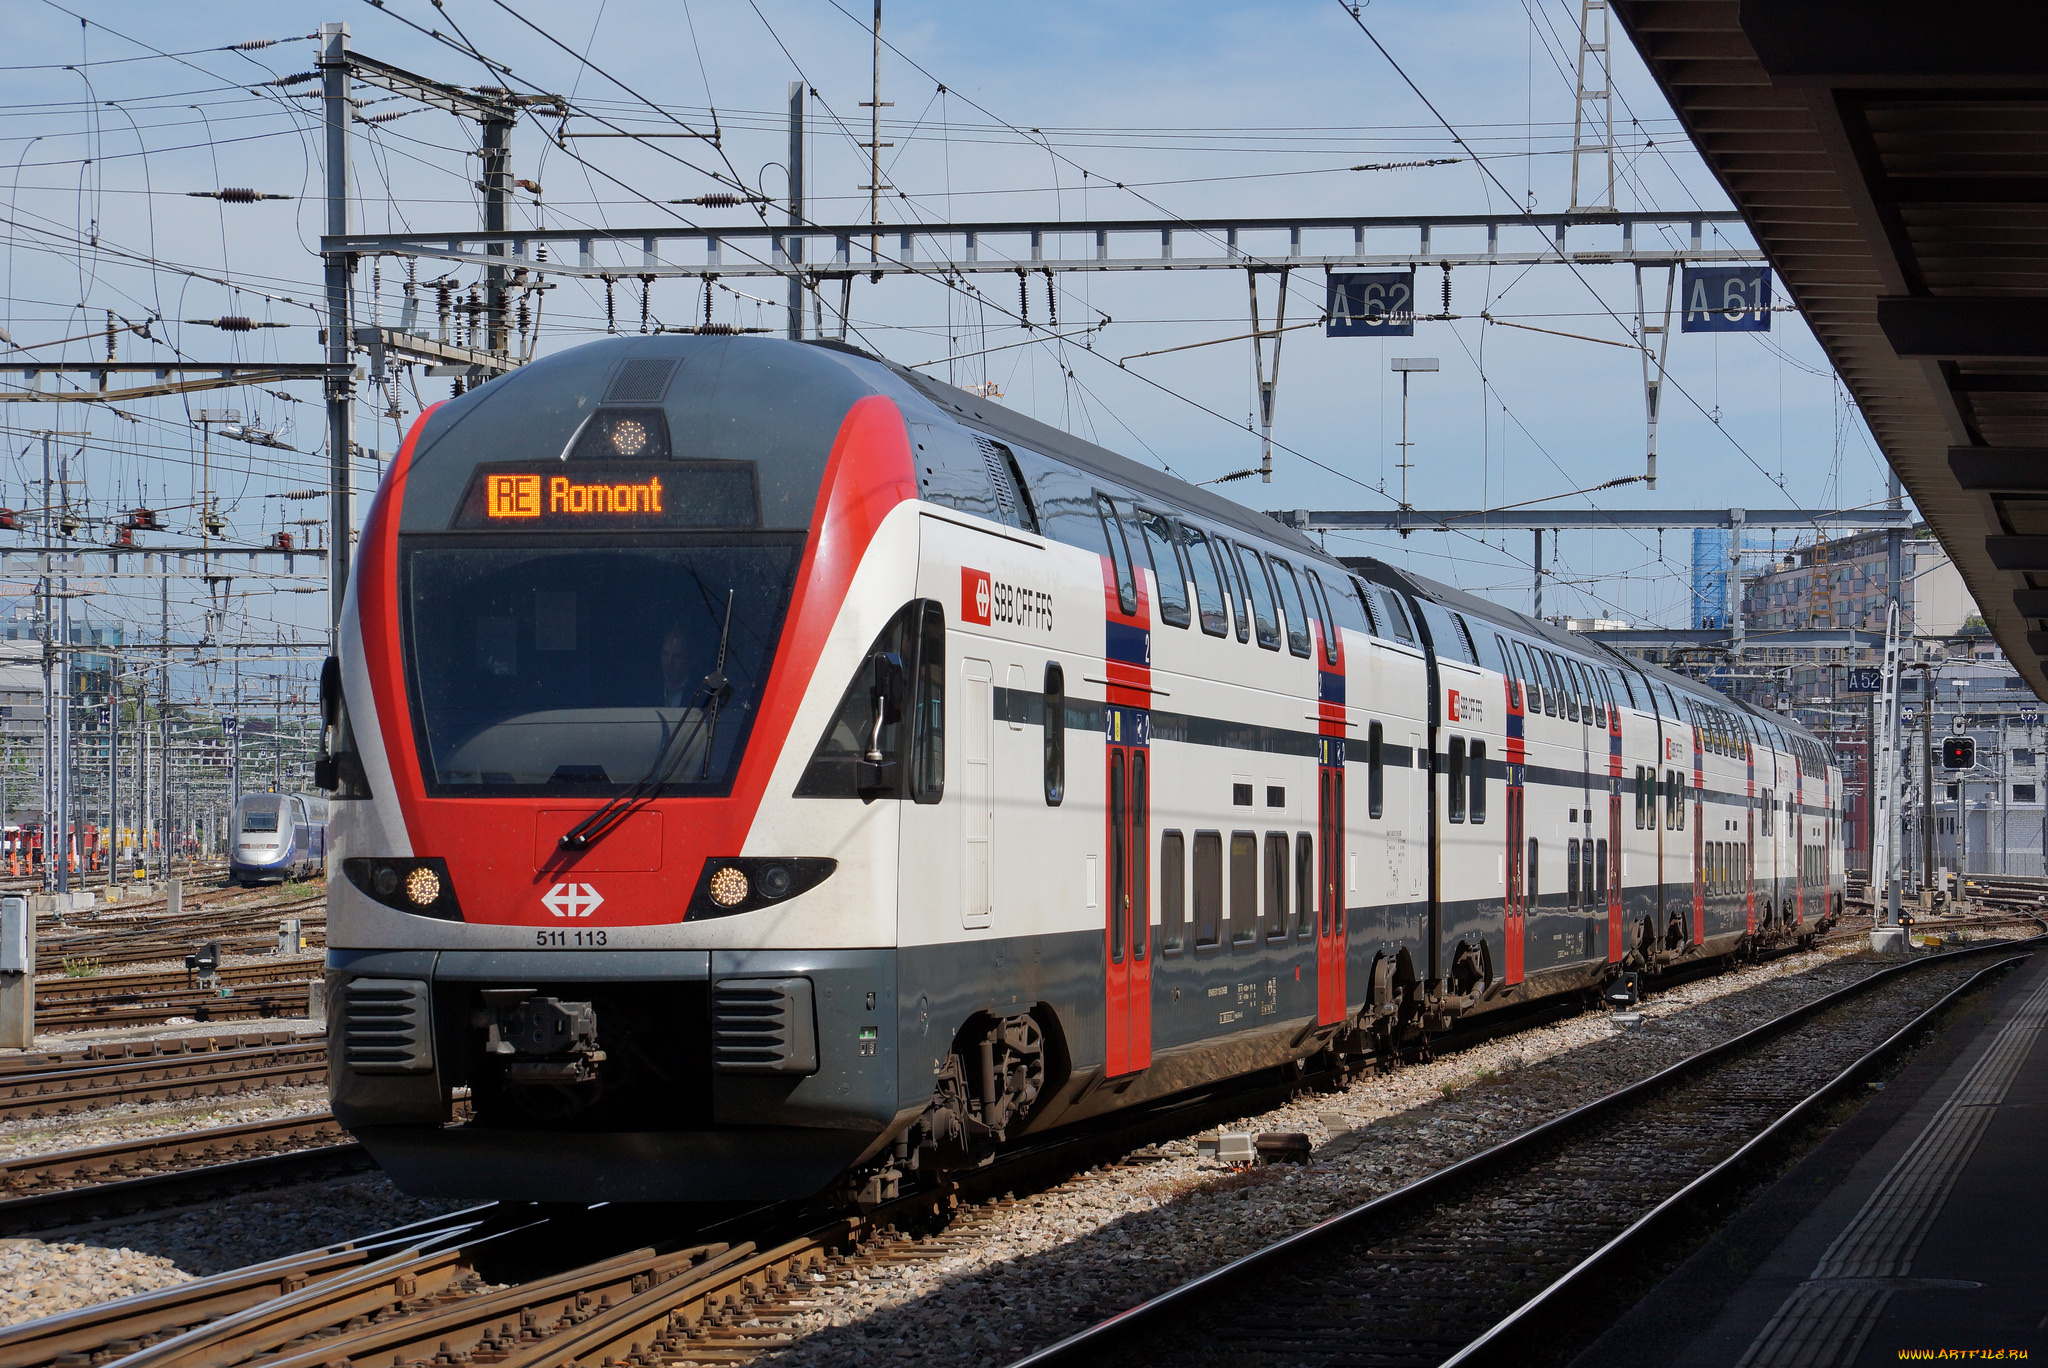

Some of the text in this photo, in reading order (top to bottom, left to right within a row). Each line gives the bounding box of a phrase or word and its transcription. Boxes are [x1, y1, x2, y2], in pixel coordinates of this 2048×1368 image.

[1330, 283, 1410, 326] A 62
[1688, 278, 1761, 321] A 61
[496, 476, 662, 513] RE Romont
[994, 581, 1053, 632] SBB CFF FFS
[1145, 634, 1150, 663] 2
[1849, 672, 1880, 688] A 52
[224, 721, 236, 734] 12
[1106, 710, 1111, 740] 2
[1145, 715, 1150, 744] 2
[536, 930, 608, 946] 511 113
